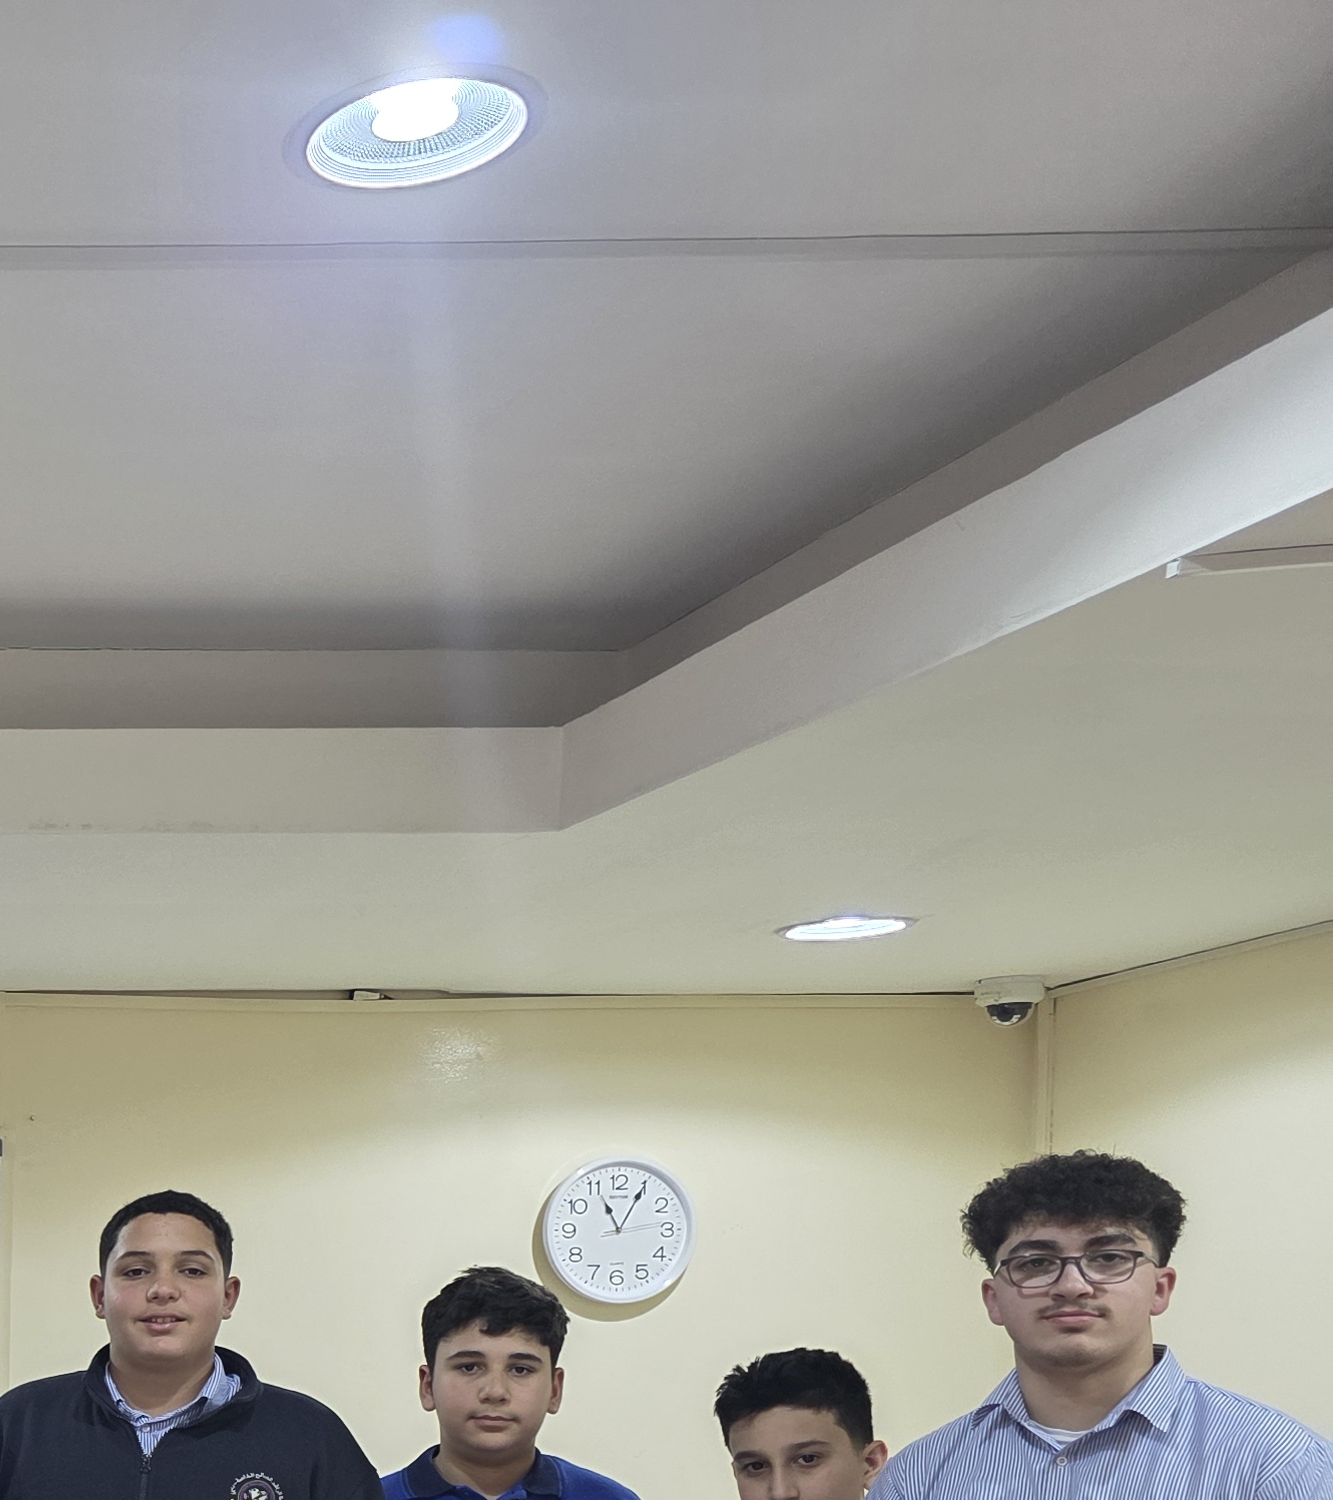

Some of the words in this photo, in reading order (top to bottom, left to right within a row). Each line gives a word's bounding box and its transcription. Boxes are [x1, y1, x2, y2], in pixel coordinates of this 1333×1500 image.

[586, 1180, 600, 1196] 11
[609, 1174, 629, 1191] 12
[568, 1198, 588, 1214] 10
[655, 1197, 669, 1213] 2
[562, 1223, 576, 1238] 9
[660, 1222, 674, 1238] 3
[568, 1247, 583, 1263] 8
[652, 1246, 667, 1262] 4
[587, 1264, 601, 1280] 7
[609, 1270, 624, 1286] 6
[634, 1264, 649, 1280] 5
